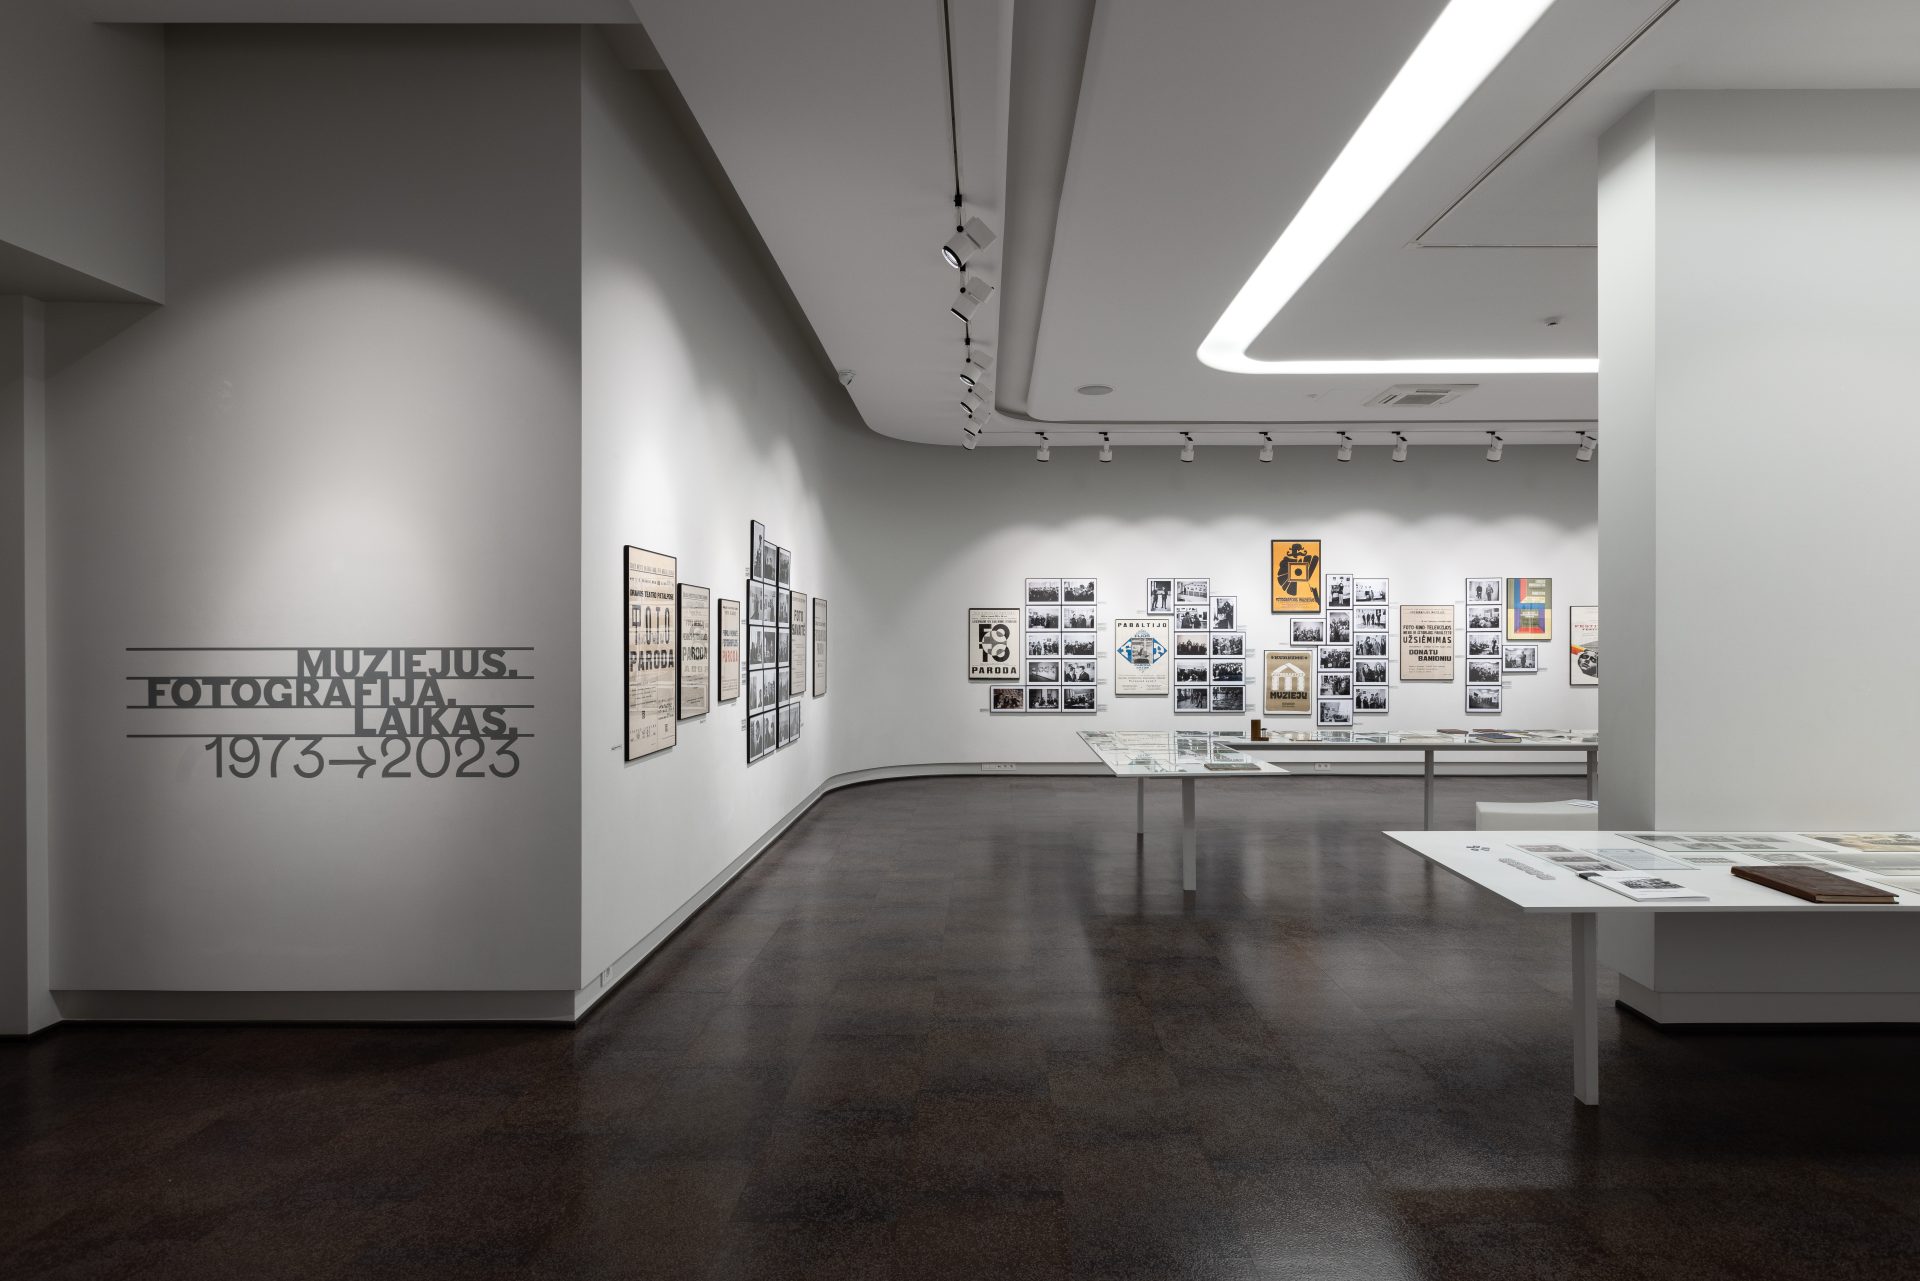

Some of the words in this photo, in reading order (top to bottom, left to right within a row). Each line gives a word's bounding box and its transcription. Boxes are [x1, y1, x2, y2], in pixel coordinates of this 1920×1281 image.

[298, 648, 518, 678] MUZIEJUS.
[630, 649, 674, 672] PARODA
[147, 677, 457, 707] FOTOGRAFIJA.
[354, 706, 518, 736] LAIKAS.
